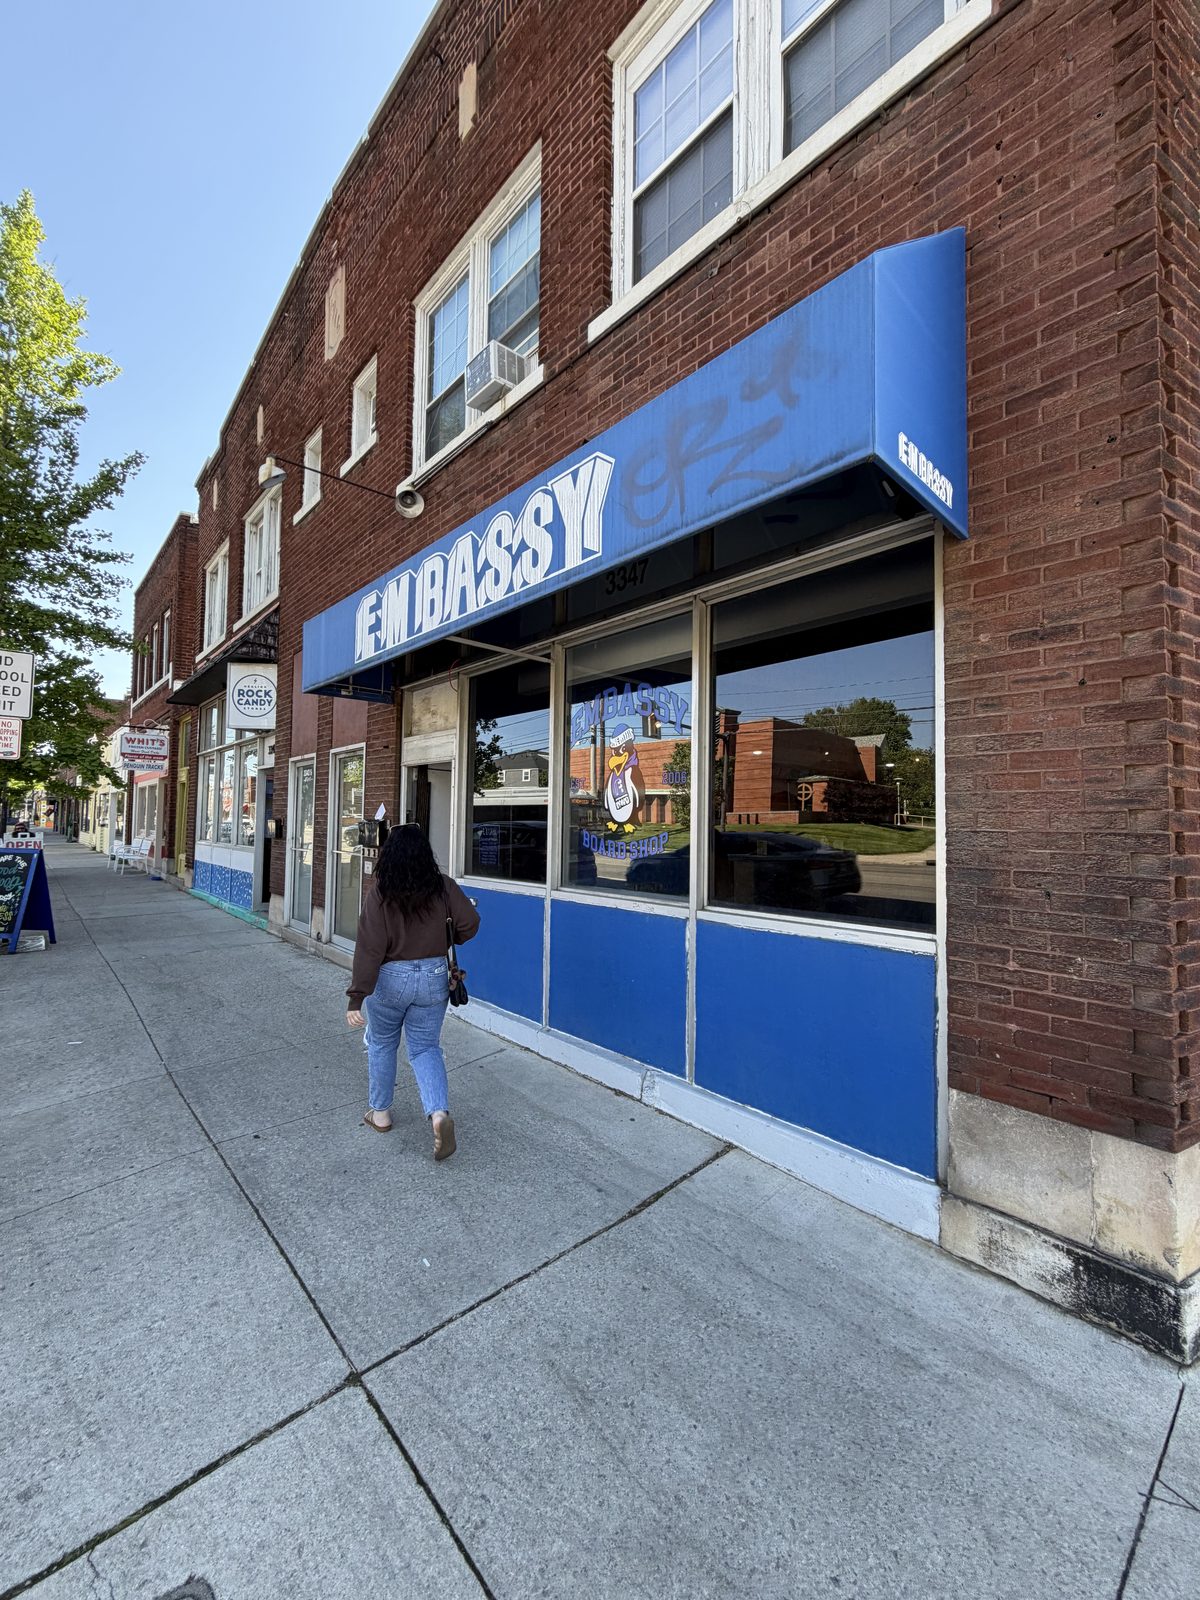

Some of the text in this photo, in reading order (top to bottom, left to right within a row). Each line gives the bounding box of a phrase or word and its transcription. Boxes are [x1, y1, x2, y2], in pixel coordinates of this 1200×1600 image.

[898, 431, 954, 509] EMBASSY
[355, 451, 615, 664] EMBASSY
[605, 558, 649, 595] 3347
[237, 689, 273, 698] ROCK
[237, 698, 273, 706] CANDY
[570, 682, 689, 748] EMBASSY
[125, 737, 165, 746] WHIT'S
[6, 841, 41, 849] OPEN
[582, 828, 669, 860] BOARD SHOP
